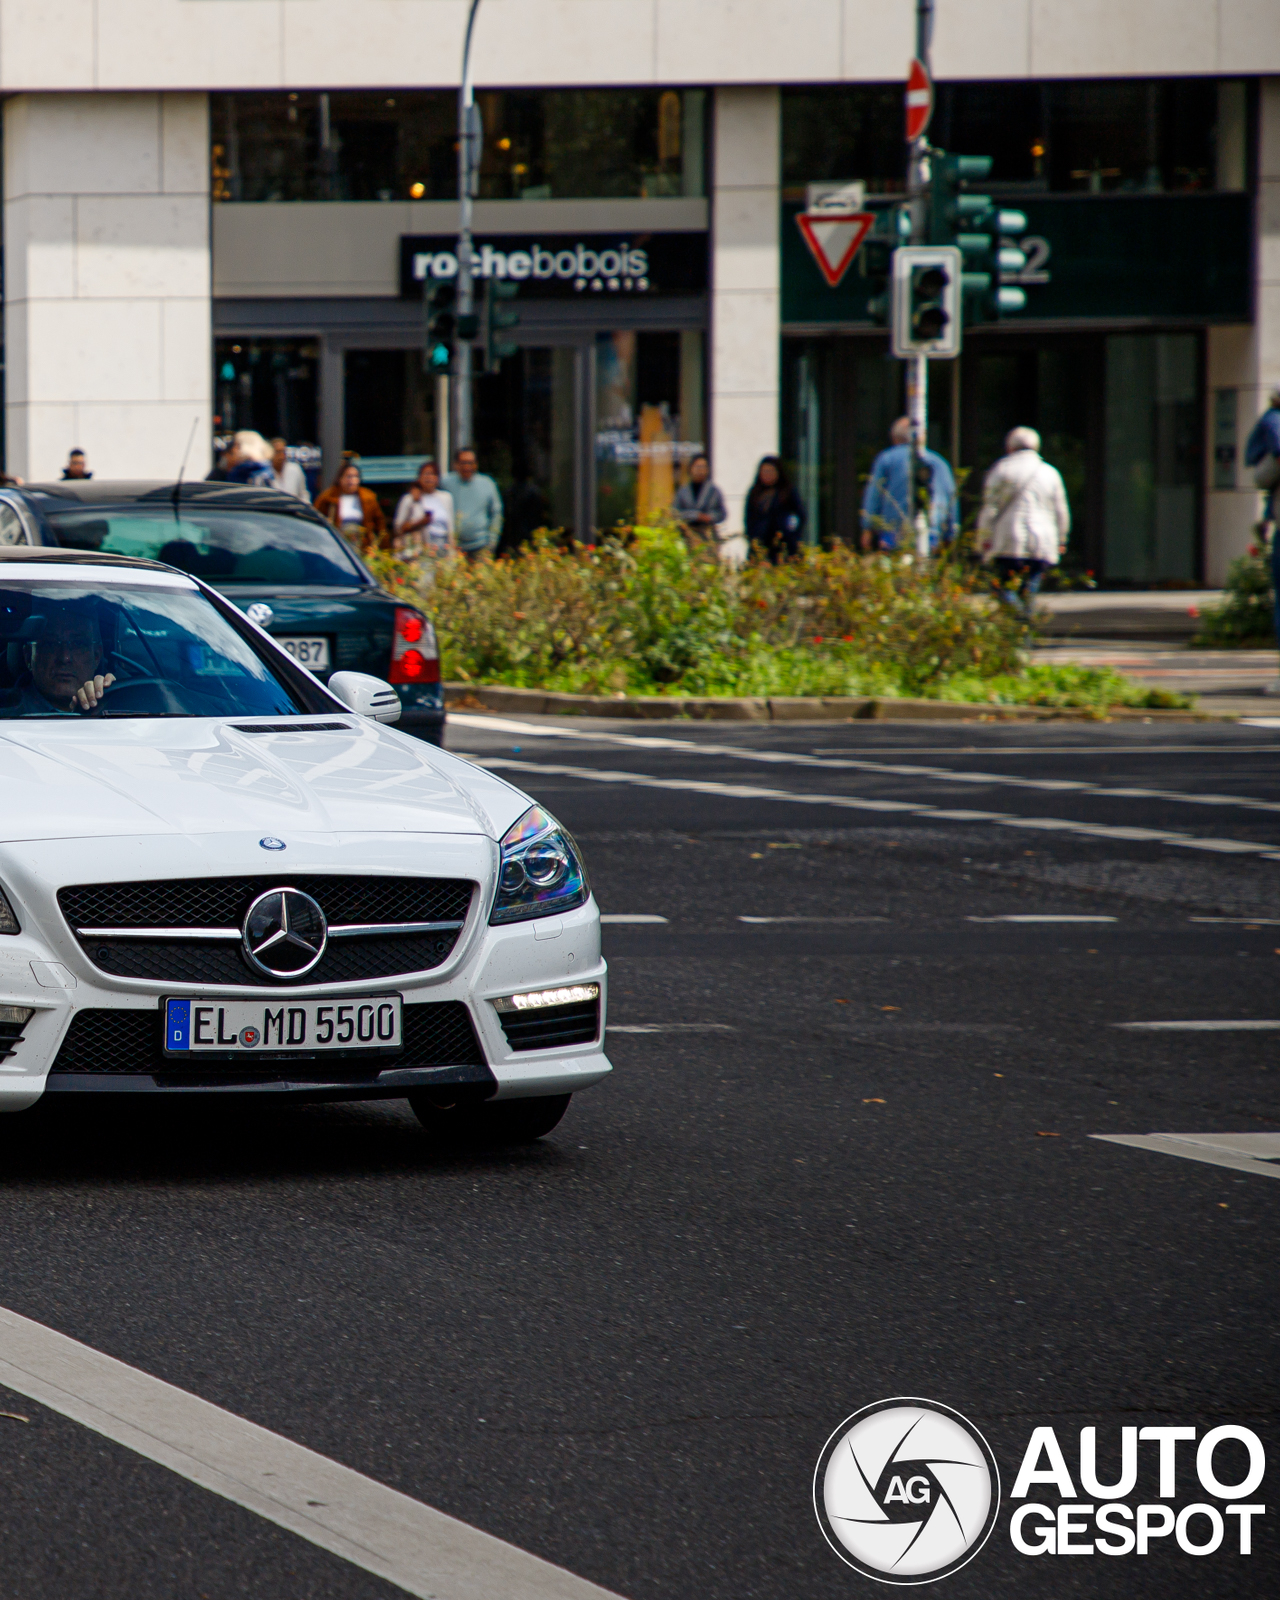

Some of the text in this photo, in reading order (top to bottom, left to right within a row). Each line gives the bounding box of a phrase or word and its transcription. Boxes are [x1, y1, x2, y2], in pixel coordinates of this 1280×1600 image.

[174, 1031, 182, 1041] D
[194, 1004, 394, 1045] EL MD 5500
